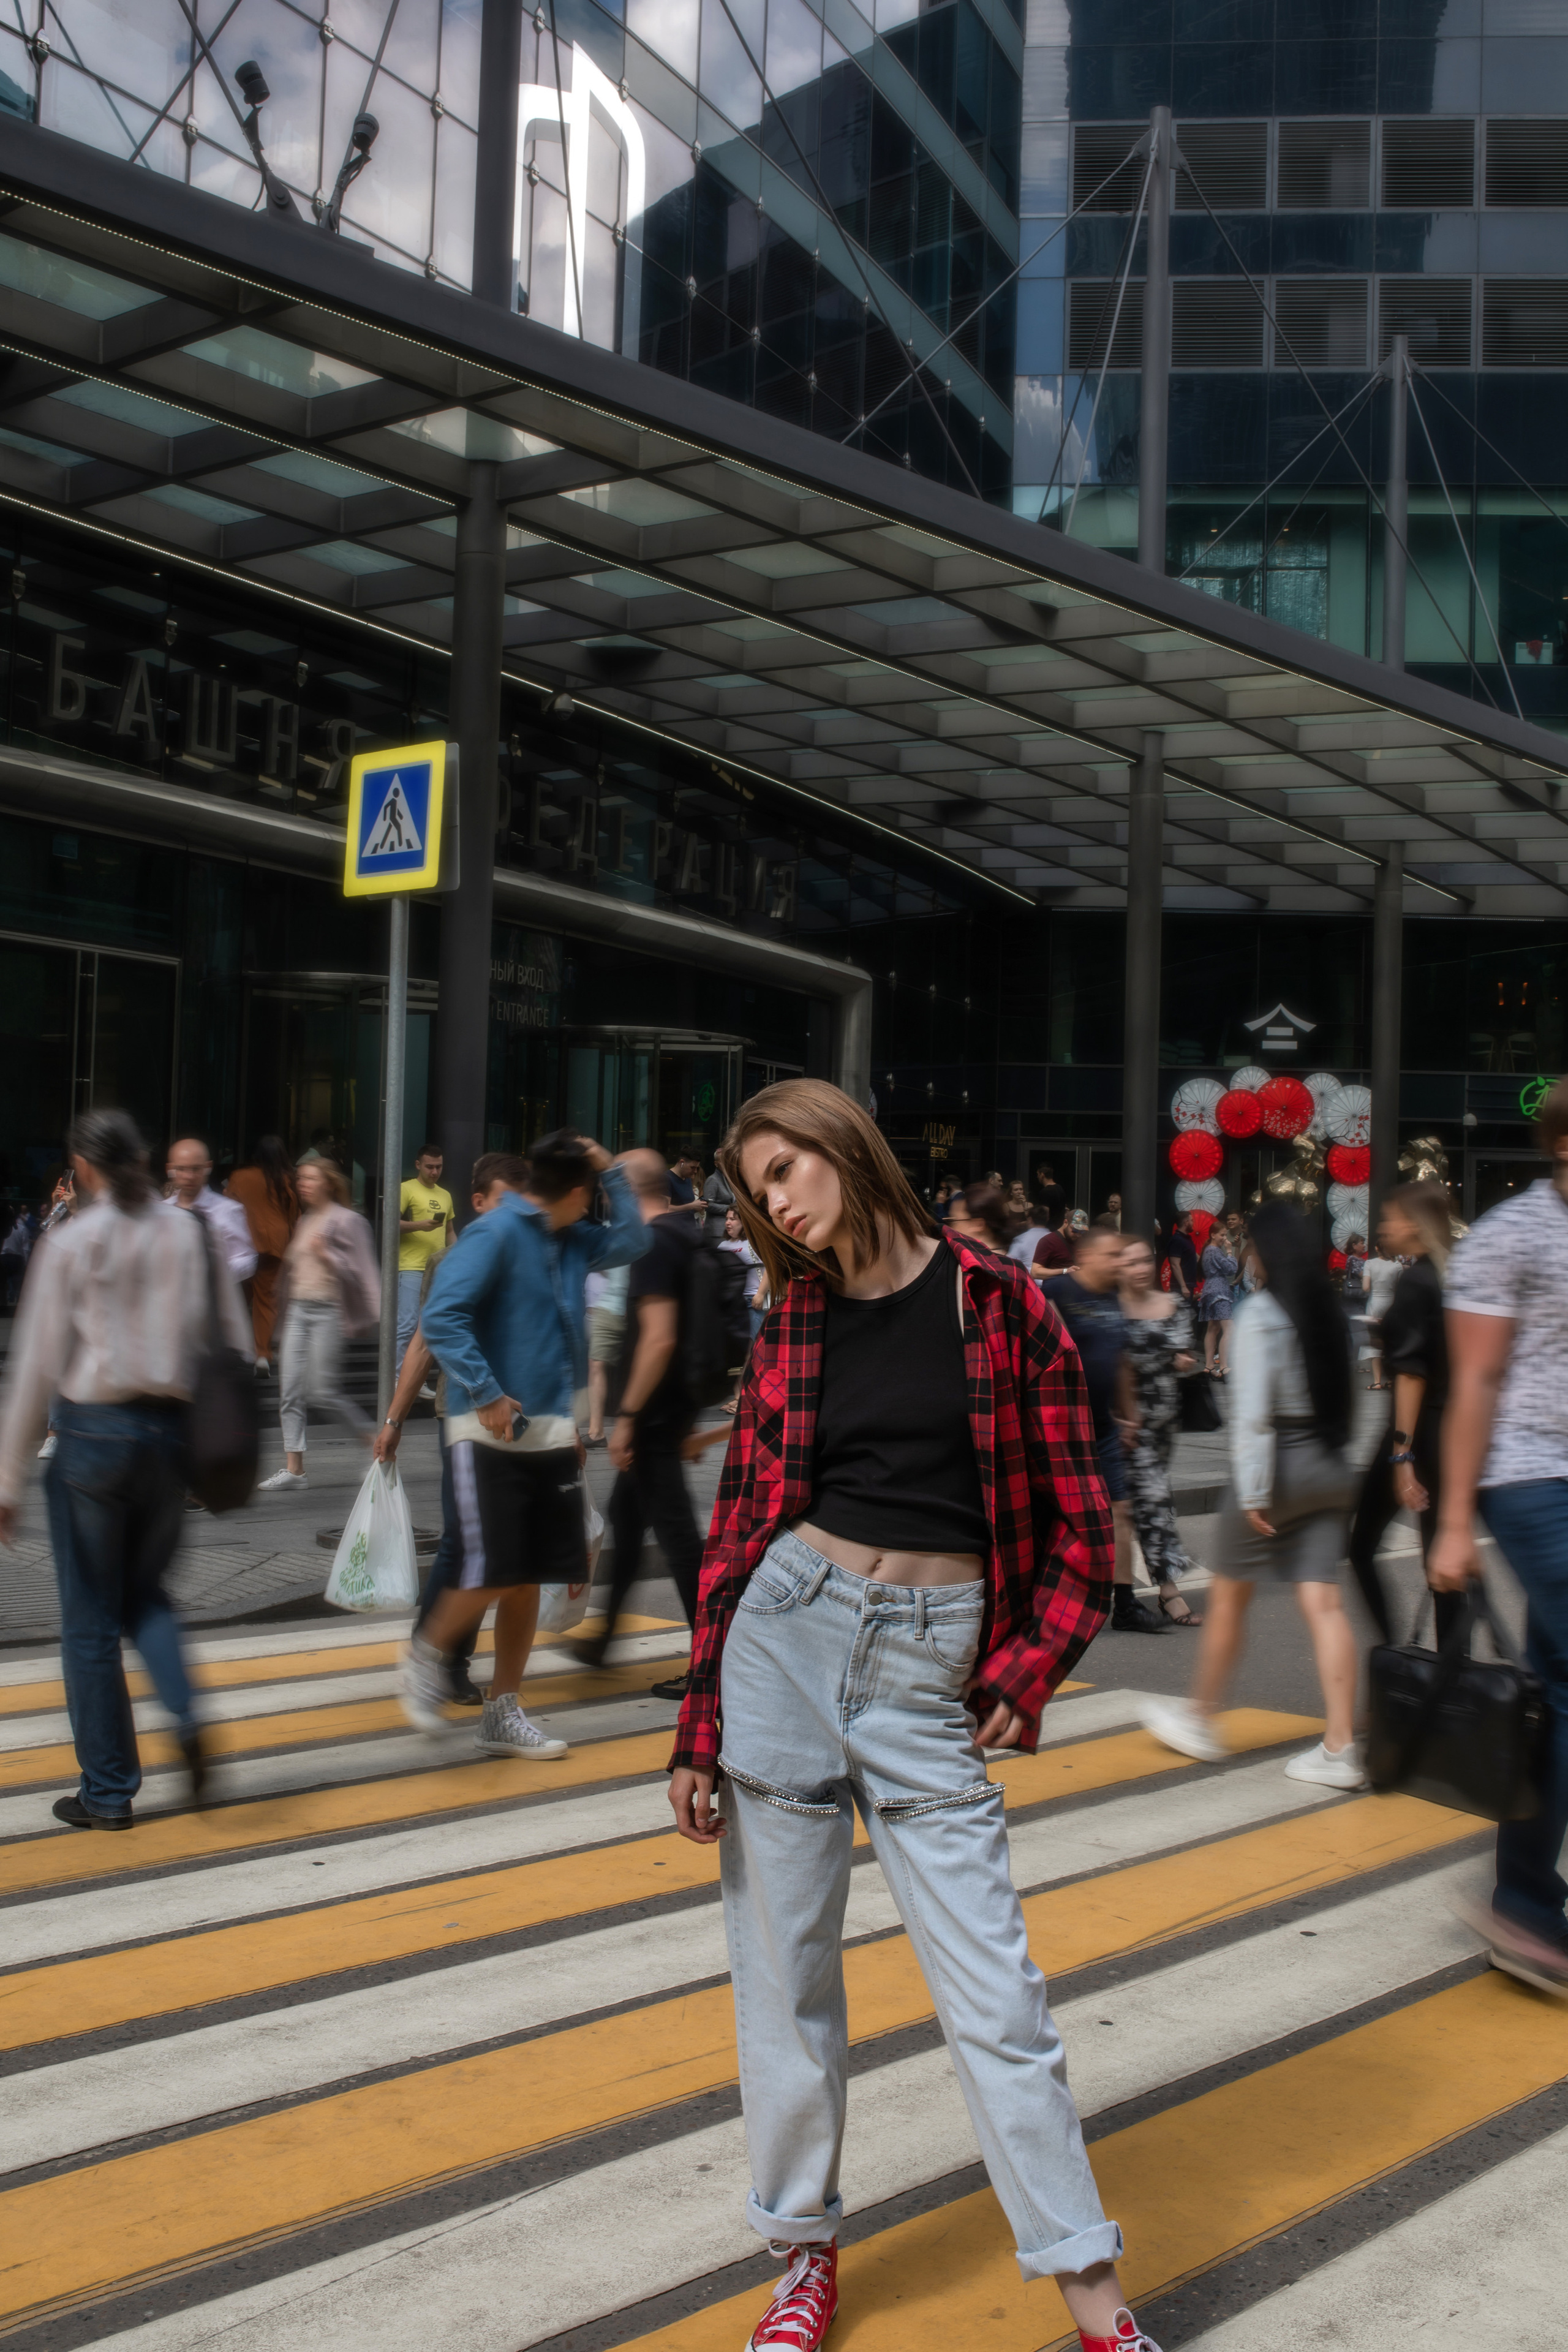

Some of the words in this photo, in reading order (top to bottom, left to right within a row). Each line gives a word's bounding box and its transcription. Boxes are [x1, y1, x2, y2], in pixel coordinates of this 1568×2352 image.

[48, 633, 356, 790] БАШНЯ
[518, 965, 544, 993] ВХОД
[496, 1000, 549, 1028] ENTRANCE
[922, 1122, 938, 1144] ALL
[939, 1123, 956, 1146] DAY
[930, 1146, 949, 1159] BISTRO
